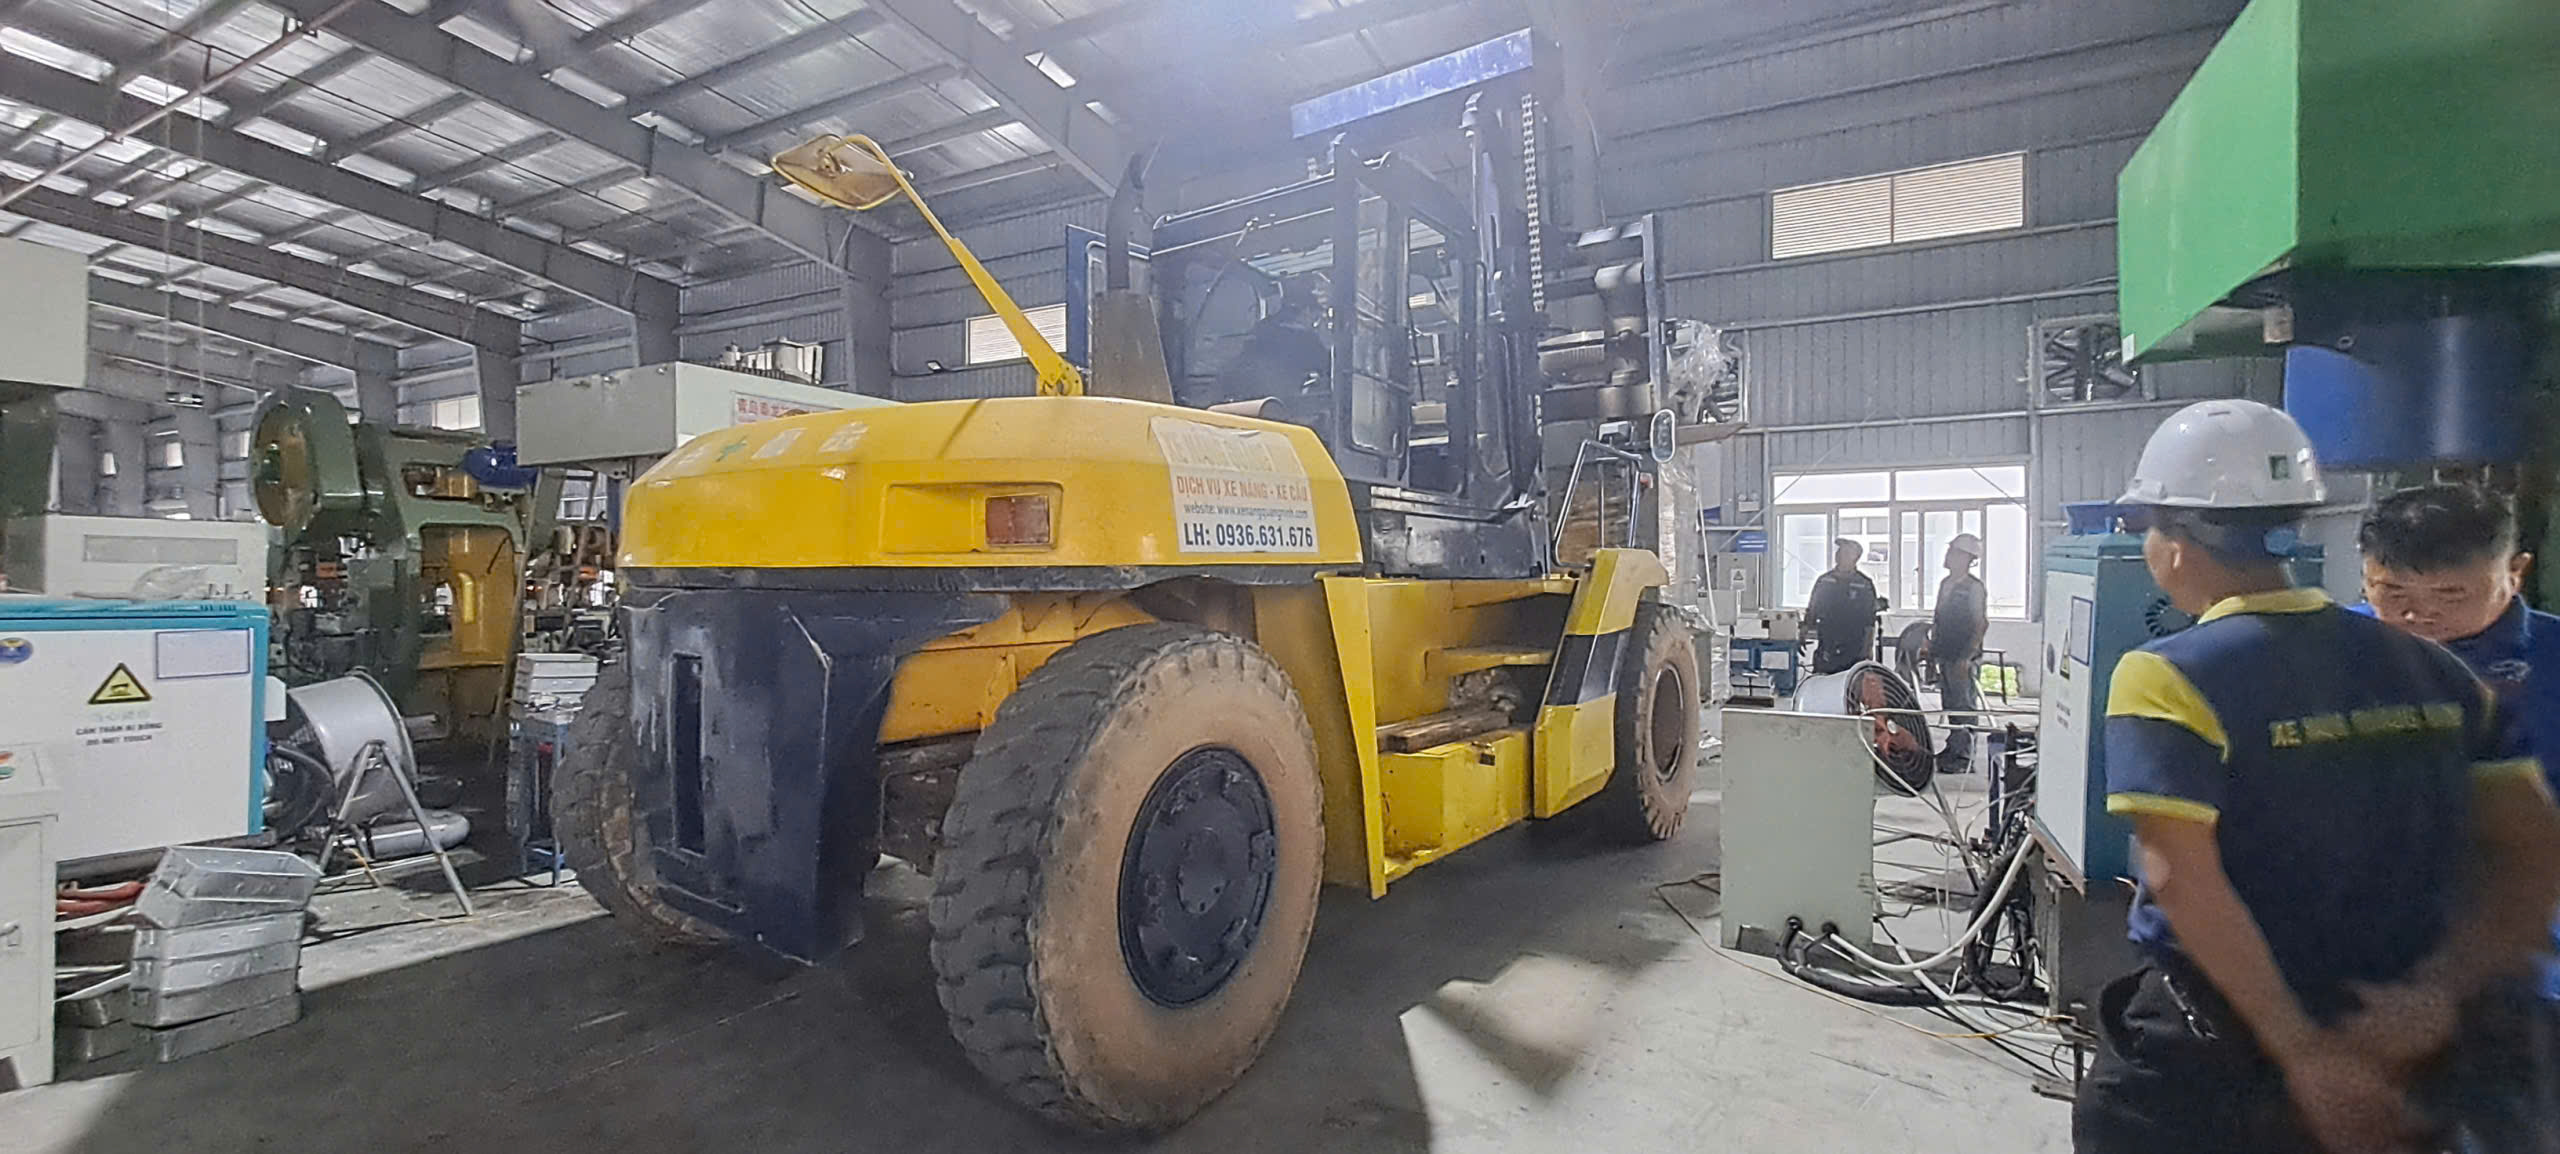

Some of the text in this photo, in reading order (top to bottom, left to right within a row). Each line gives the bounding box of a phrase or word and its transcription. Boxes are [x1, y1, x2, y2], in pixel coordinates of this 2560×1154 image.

[1176, 475, 1205, 498] DỊCH
[1206, 478, 1221, 500] VỤ
[1222, 479, 1238, 497] XE
[1276, 484, 1289, 501] XE
[1184, 501, 1216, 514] website:
[1184, 523, 1313, 547] LH: 0936.631.676
